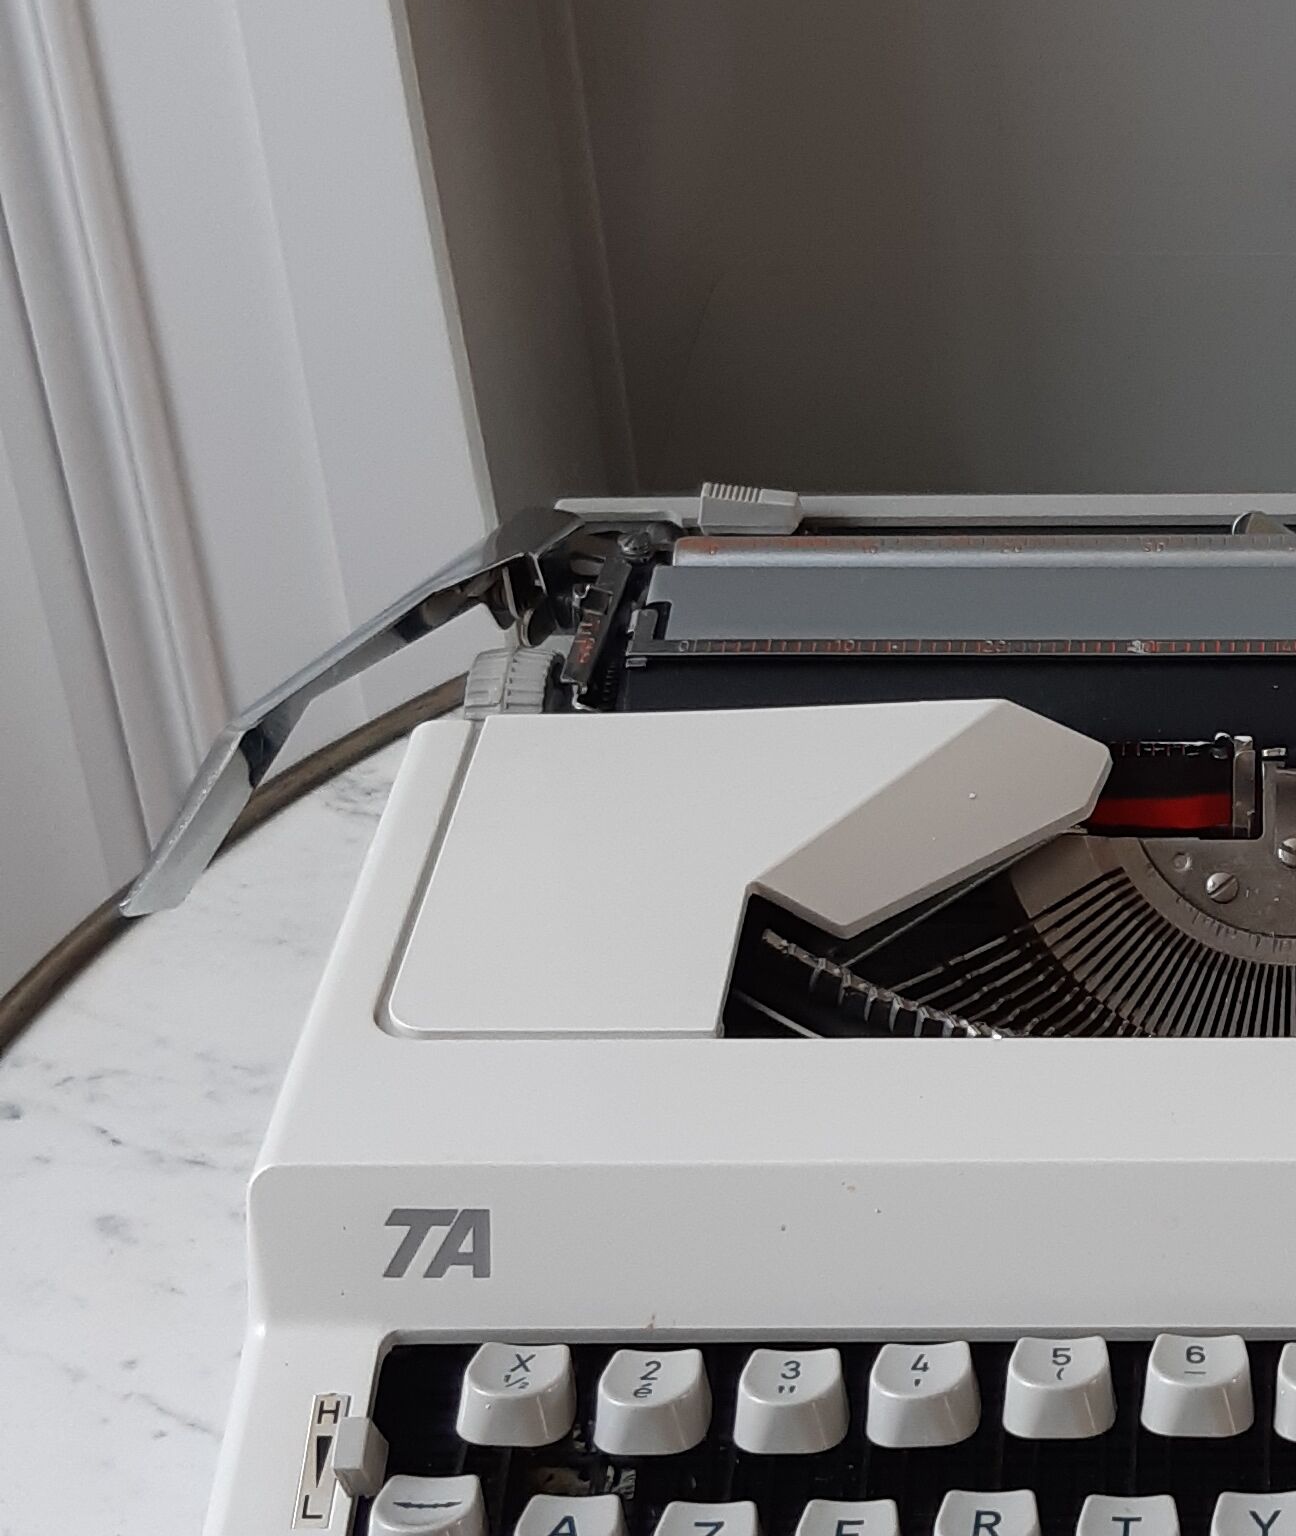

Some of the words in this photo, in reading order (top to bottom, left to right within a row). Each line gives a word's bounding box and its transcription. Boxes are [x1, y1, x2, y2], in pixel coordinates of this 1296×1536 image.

[382, 1208, 491, 1279] TA
[910, 1353, 929, 1373] 4
[1051, 1347, 1072, 1366] 5
[1185, 1345, 1206, 1364] 6
[639, 1360, 662, 1381] 2
[780, 1360, 801, 1380] 3
[632, 1382, 653, 1399] é
[316, 1400, 341, 1425] H
[301, 1494, 323, 1520] L
